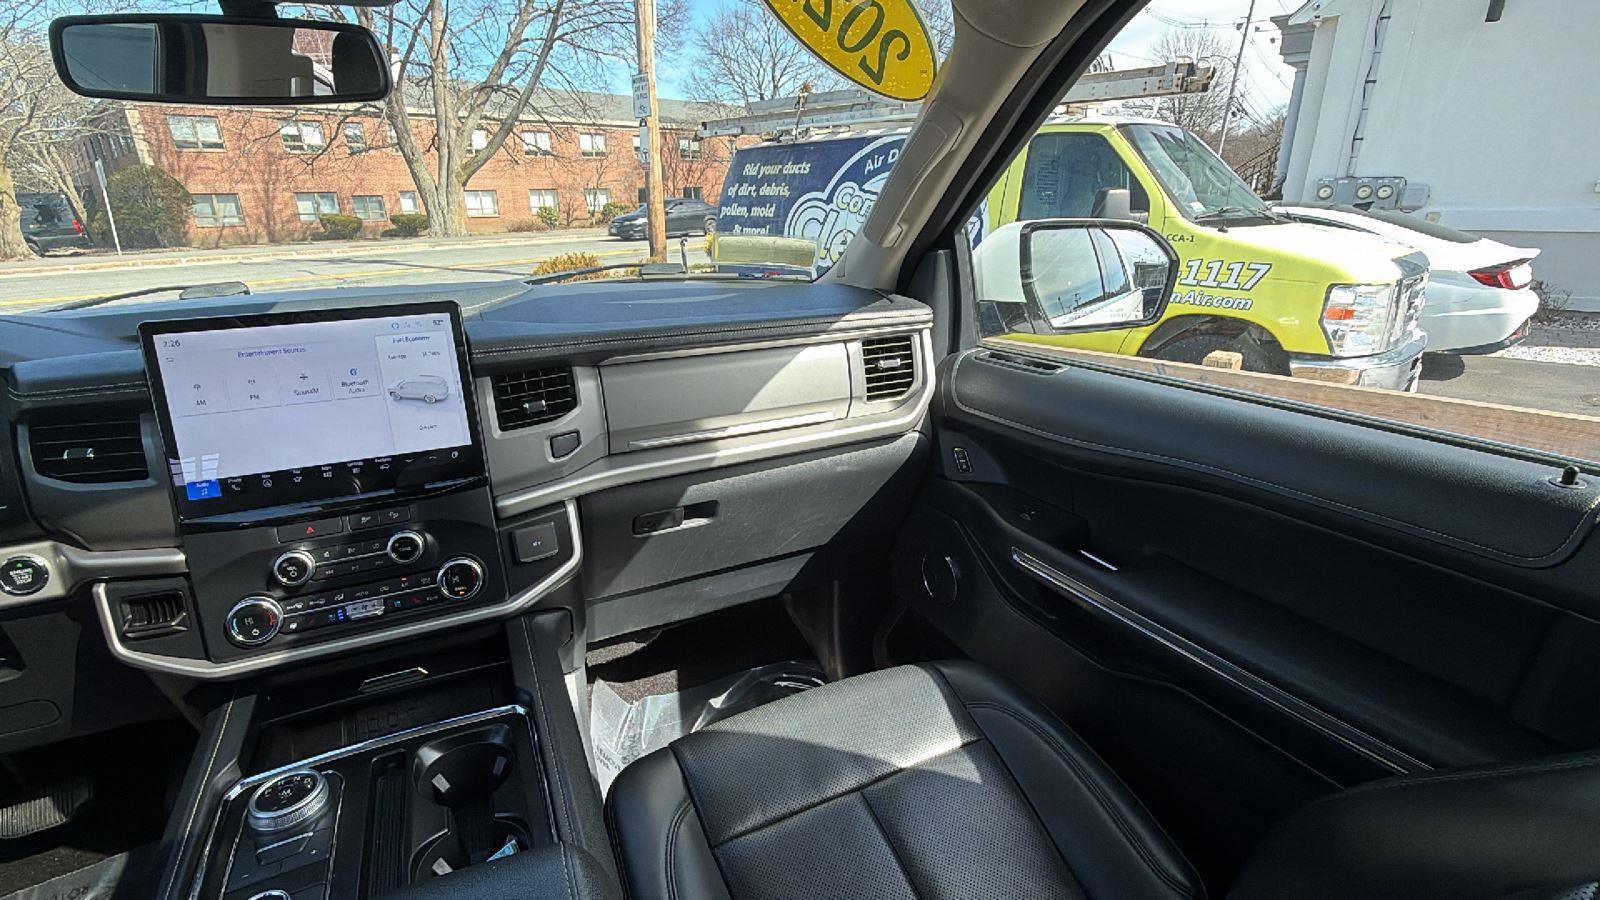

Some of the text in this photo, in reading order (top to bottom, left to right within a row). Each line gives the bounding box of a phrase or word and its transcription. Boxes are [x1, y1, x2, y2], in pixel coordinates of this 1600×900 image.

[742, 161, 811, 178] Rid your ducts
[864, 148, 900, 175] Air D
[728, 183, 790, 198] of dirt, debris,
[720, 203, 776, 219] pollen, mold
[1166, 233, 1195, 242] CCA-1
[1169, 290, 1253, 310] nAir.com
